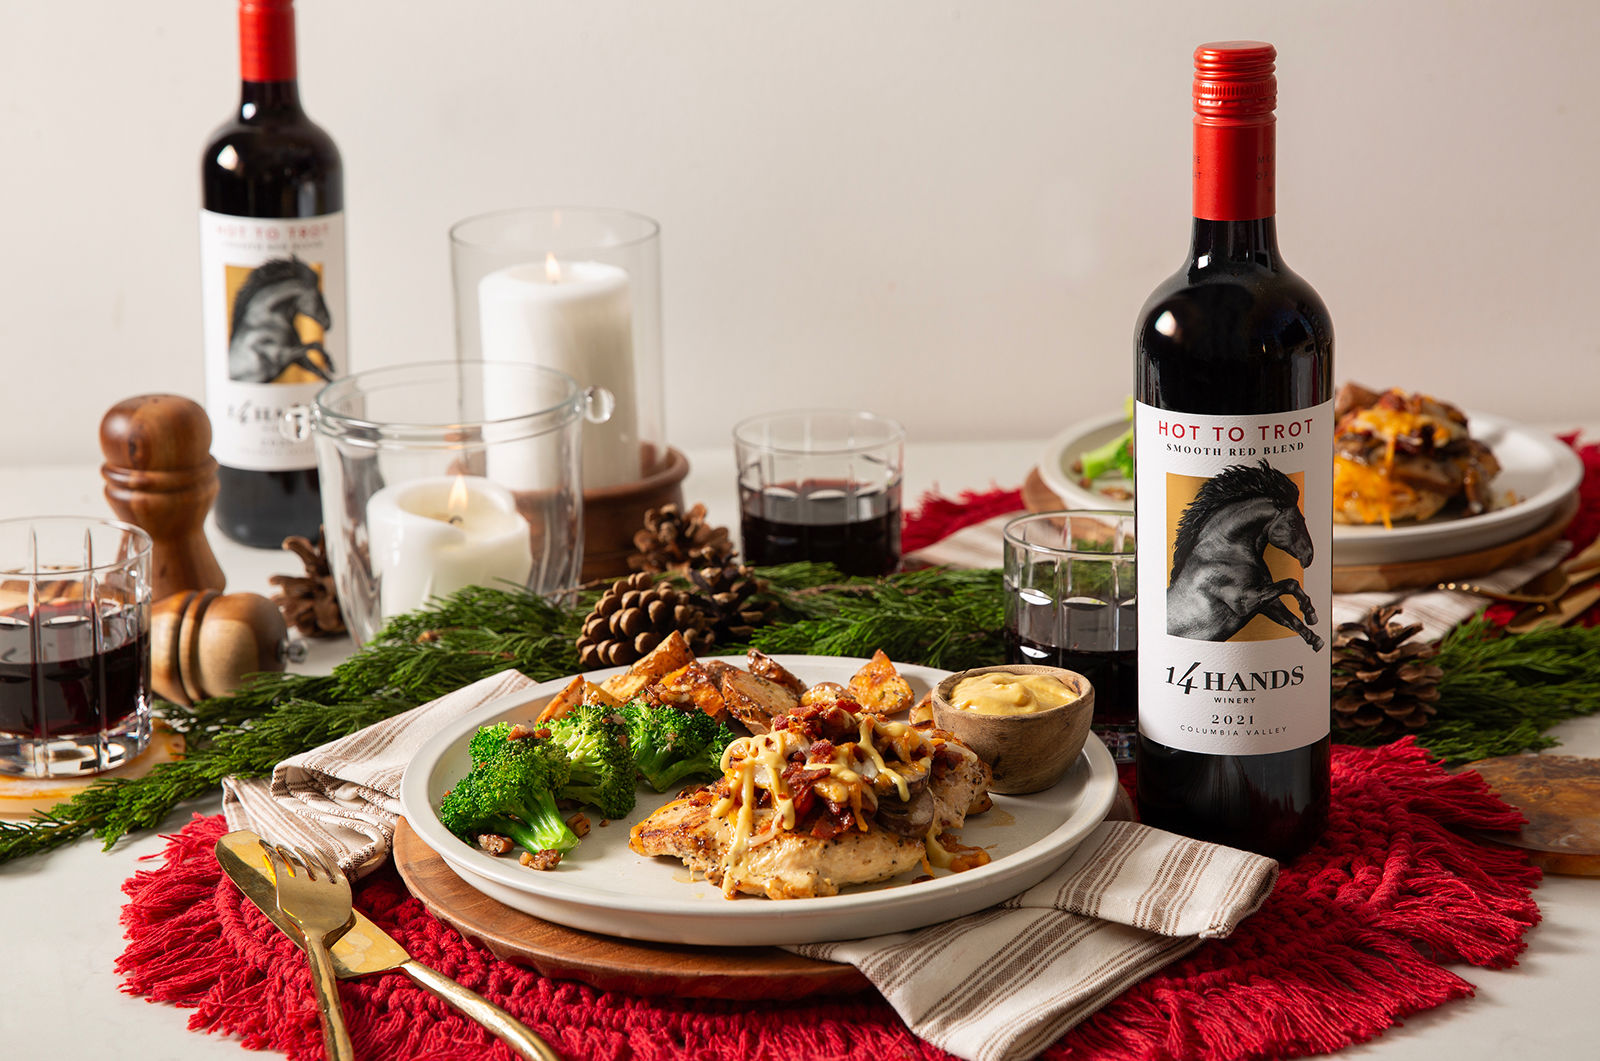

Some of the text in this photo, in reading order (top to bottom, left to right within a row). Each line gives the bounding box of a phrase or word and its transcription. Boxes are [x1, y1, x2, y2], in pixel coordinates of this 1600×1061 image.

[1158, 418, 1313, 442] HOT TO TROT
[1166, 441, 1304, 456] SMOOTH RED BLEND
[1165, 661, 1304, 695] 14 HANDS
[1213, 696, 1256, 704] WINERY
[1211, 714, 1254, 725] 2021
[1179, 724, 1287, 737] COLUMBIA VALLEY
